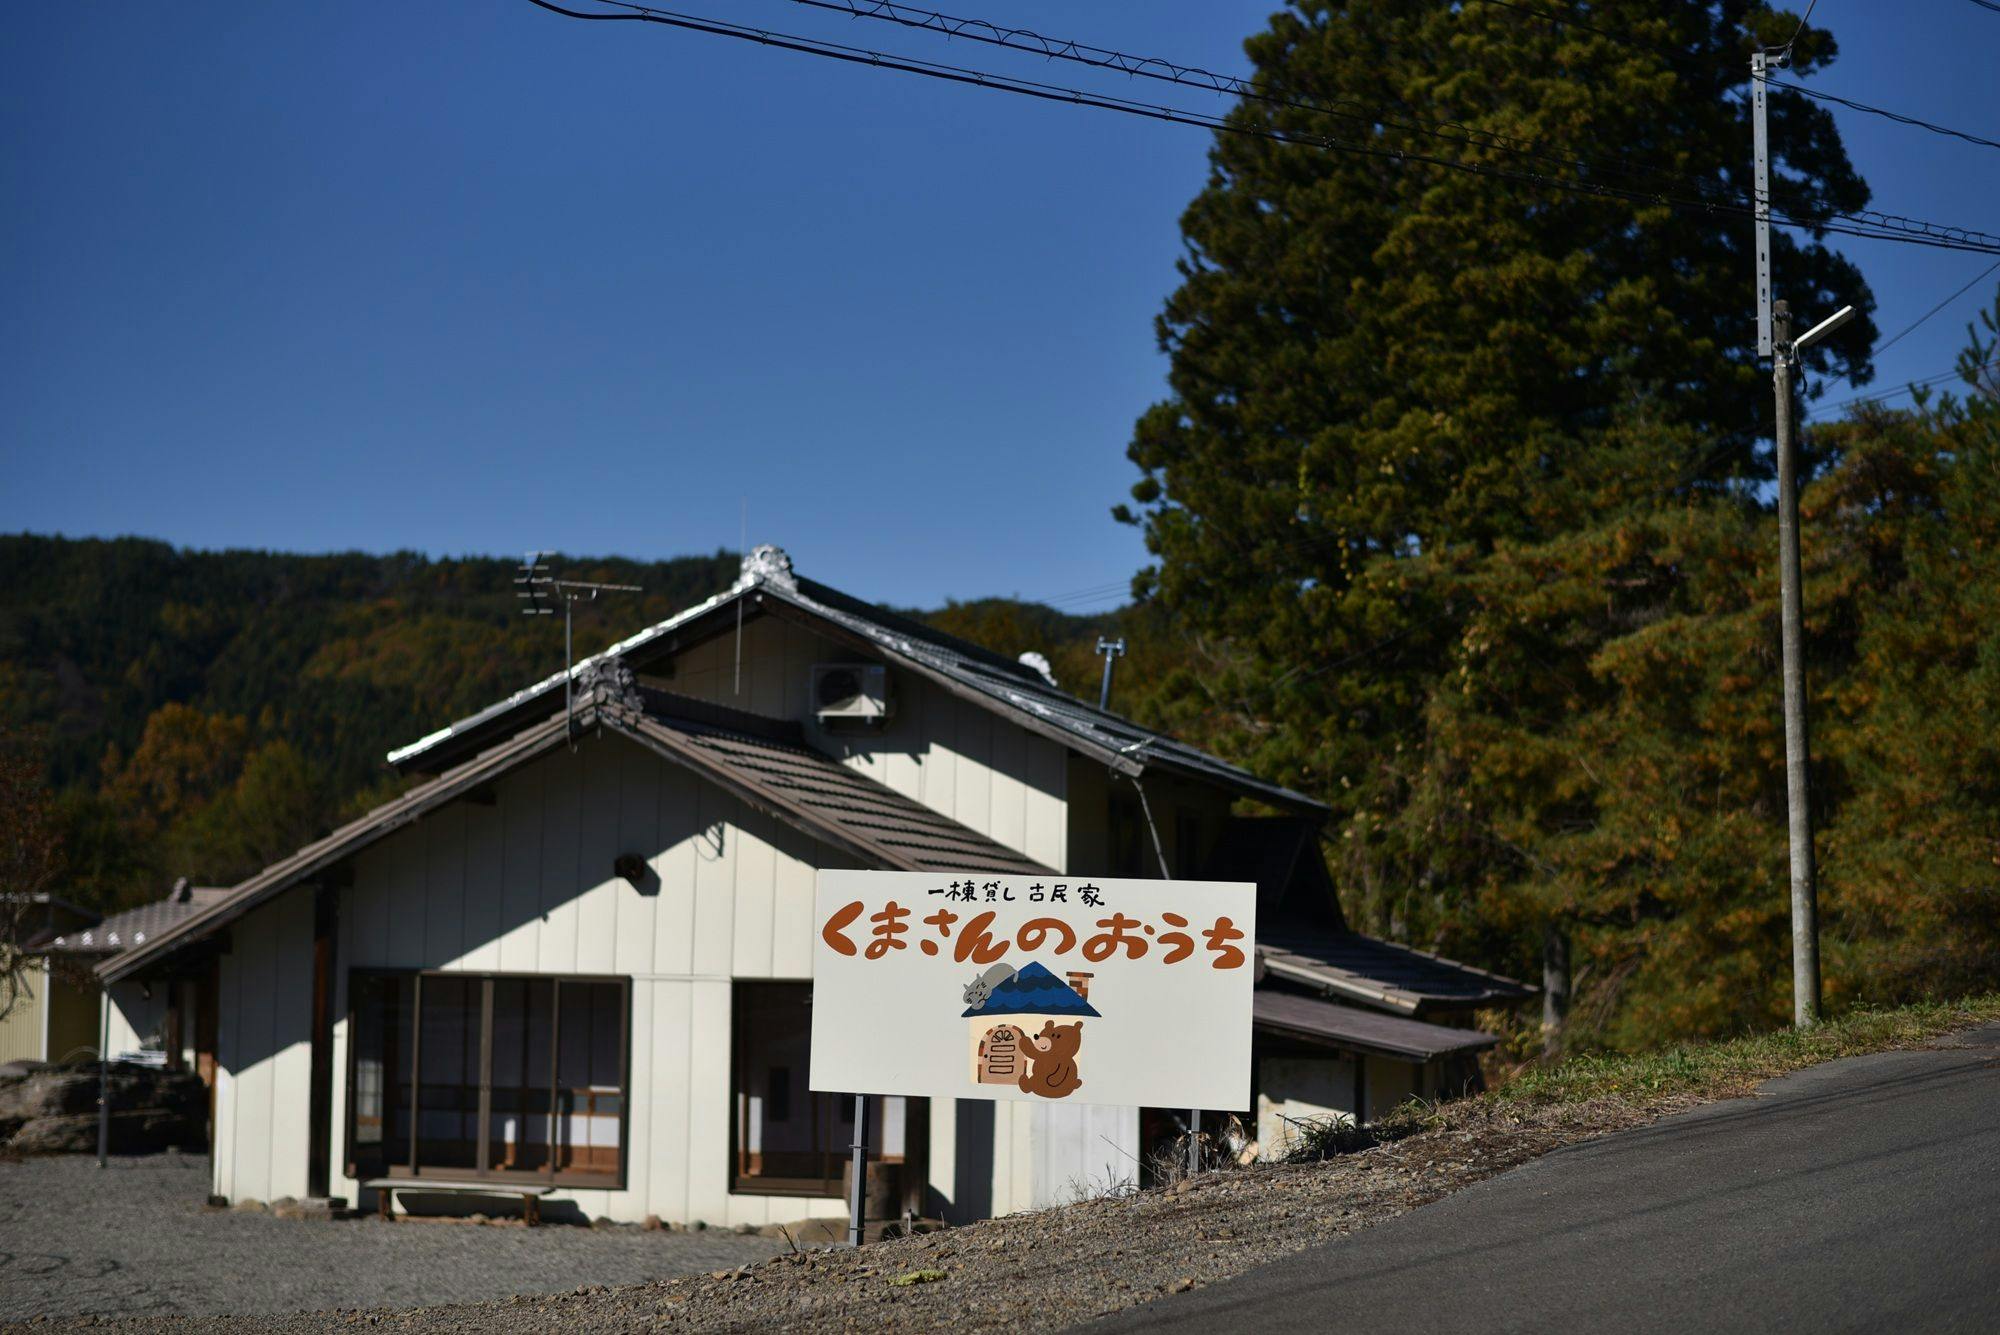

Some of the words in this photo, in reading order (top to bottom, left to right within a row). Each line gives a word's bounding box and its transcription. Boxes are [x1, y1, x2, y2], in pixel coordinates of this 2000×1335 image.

[928, 880, 1015, 902] 一棟貸し
[1029, 883, 1105, 907] 古民家
[822, 900, 1246, 970] くまさんのおうち
